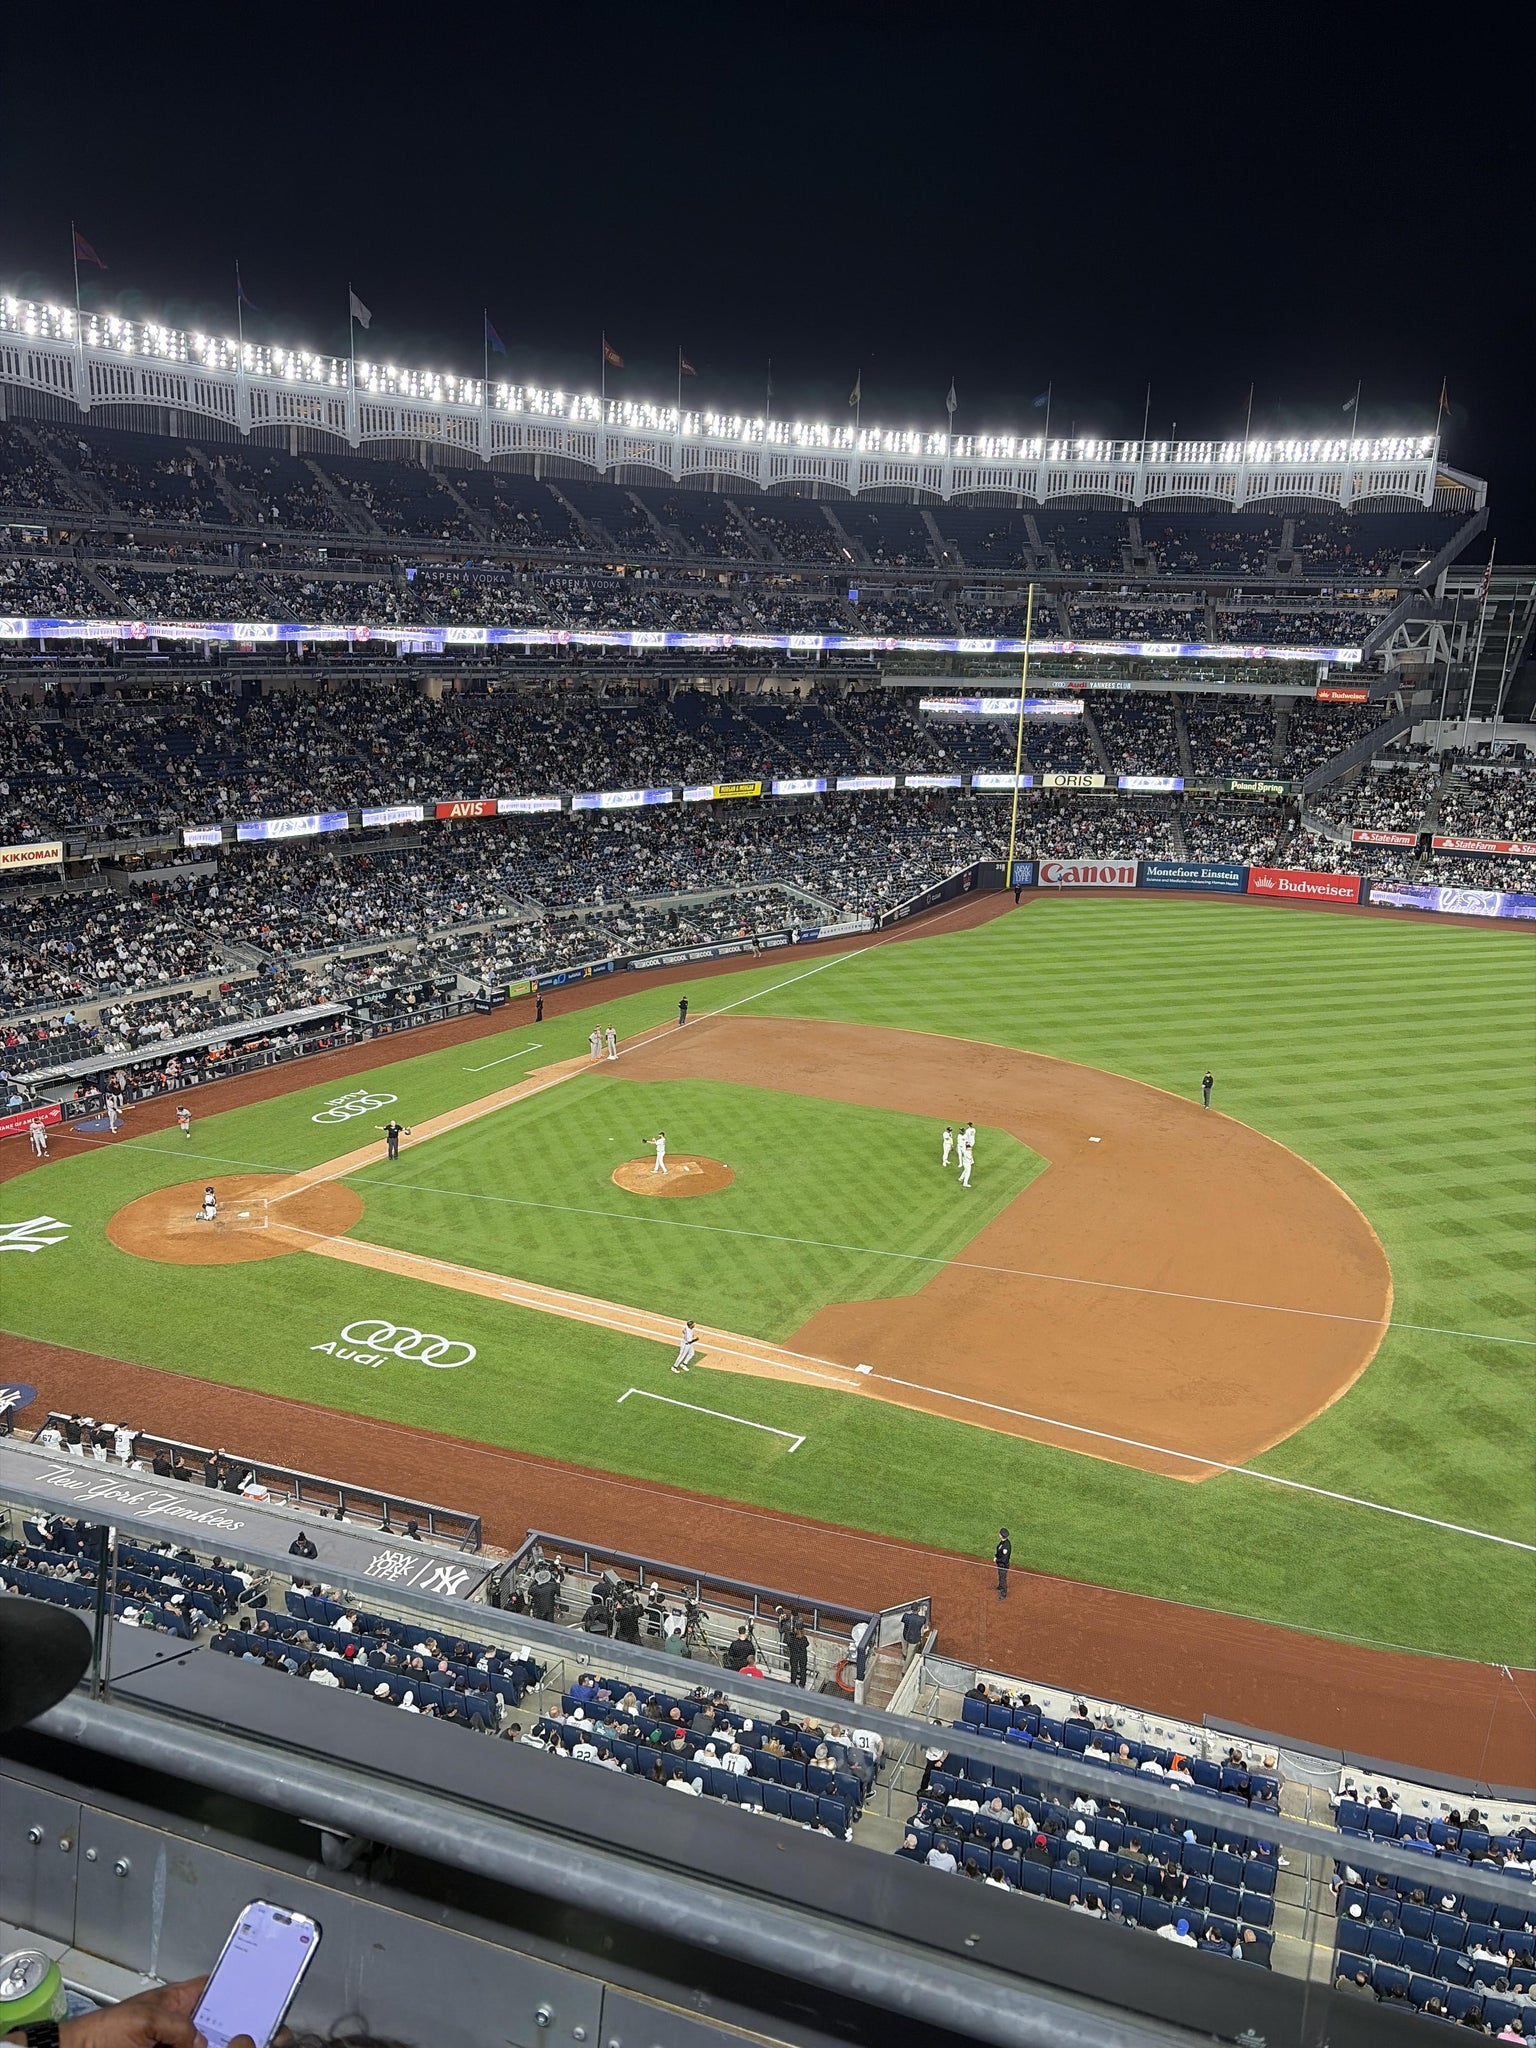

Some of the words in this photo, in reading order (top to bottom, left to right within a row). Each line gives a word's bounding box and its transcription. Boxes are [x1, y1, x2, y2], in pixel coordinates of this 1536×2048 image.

[425, 571, 460, 582] ASPEN
[472, 573, 507, 584] VODKA
[549, 578, 580, 588] ASPEN
[591, 580, 622, 590] VODKA
[1331, 691, 1367, 700] Budweiser
[1054, 775, 1093, 787] ORIS
[1230, 780, 1257, 791] Poland
[1257, 782, 1284, 794] Spring
[450, 802, 484, 817] AVIS
[2, 848, 59, 863] KIKKOMAN
[1040, 862, 1135, 884] Canon
[1147, 866, 1199, 878] Montefiore
[1201, 868, 1240, 880] Einstein
[1278, 878, 1354, 897] Budweiser
[363, 992, 388, 1003] StubHub
[323, 1089, 369, 1106] Audi
[310, 1341, 389, 1368] Audi
[42, 1434, 53, 1442] 67
[35, 1464, 92, 1490] New
[74, 1478, 157, 1506] York
[135, 1493, 245, 1531] Yankees
[378, 1549, 419, 1565] NEW
[370, 1556, 415, 1576] YORK
[363, 1565, 401, 1582] LIFE
[859, 1736, 870, 1749] 31
[576, 1750, 591, 1762] 22
[727, 1759, 736, 1770] 11
